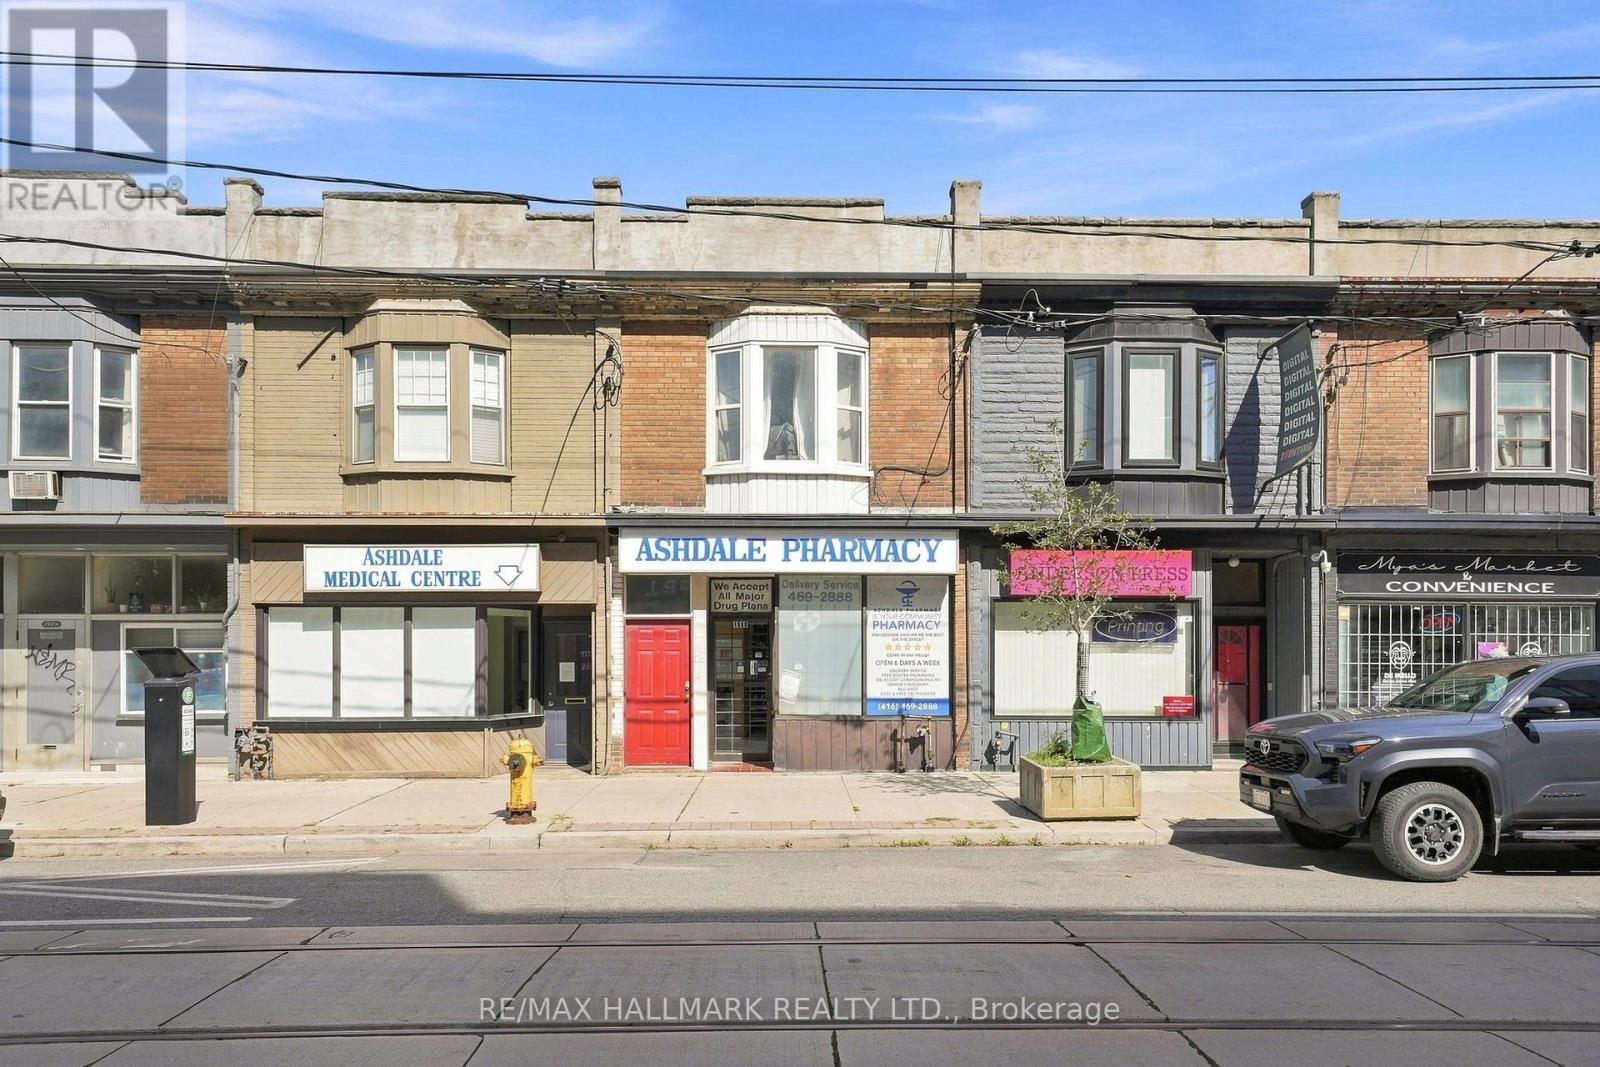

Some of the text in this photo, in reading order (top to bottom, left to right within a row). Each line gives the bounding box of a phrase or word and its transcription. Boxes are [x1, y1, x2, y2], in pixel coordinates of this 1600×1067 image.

[1282, 349, 1309, 372] DIGITAL
[1283, 364, 1312, 387] DIGITAL
[1284, 380, 1314, 402] DIGITAL
[1284, 395, 1315, 417] DIGITAL
[1284, 411, 1316, 432] DIGITAL
[1282, 427, 1314, 447] DIGITAL
[363, 547, 443, 566] ASHDALE
[635, 536, 943, 563] ASHDALE PHARMACY
[1358, 556, 1582, 575] Mya's Market
[324, 570, 481, 588] MEDICAL CENTRE
[782, 580, 859, 590] Delivery Service
[1462, 572, 1472, 581] &
[713, 582, 769, 592] We Accept
[1385, 581, 1555, 594] CONVENIENCE
[718, 592, 765, 601] All Major
[788, 591, 853, 602] 469-2888
[713, 602, 769, 611] Drug Plans
[872, 620, 941, 630] PHARMACY
[877, 703, 899, 711] (416)
